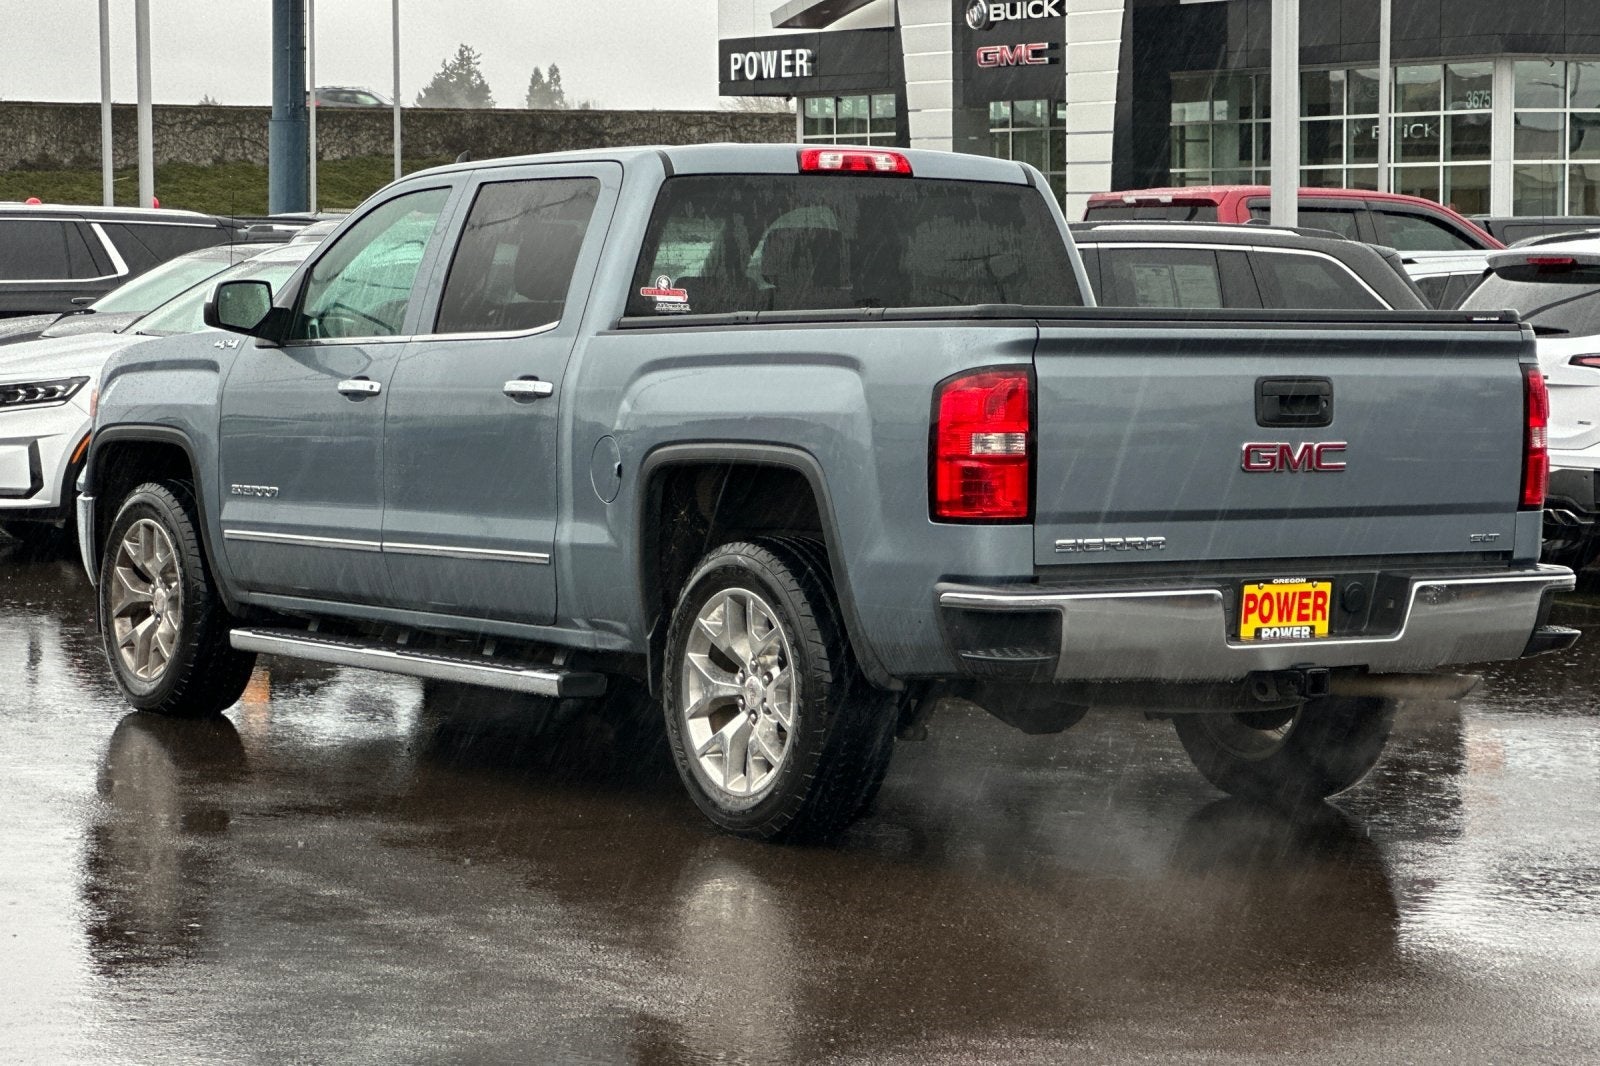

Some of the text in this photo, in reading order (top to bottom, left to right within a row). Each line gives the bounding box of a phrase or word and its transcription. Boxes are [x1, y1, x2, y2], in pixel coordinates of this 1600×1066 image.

[989, 0, 1061, 22] BUICK
[730, 48, 812, 81] POWER
[976, 43, 1049, 68] GMC
[1465, 90, 1491, 109] 3675
[1371, 123, 1439, 140] BICK
[1241, 441, 1348, 472] GMC
[1055, 536, 1166, 553] SIERRA
[1470, 533, 1501, 543] SLT
[1243, 590, 1328, 625] POWER
[1261, 626, 1311, 639] POWER
